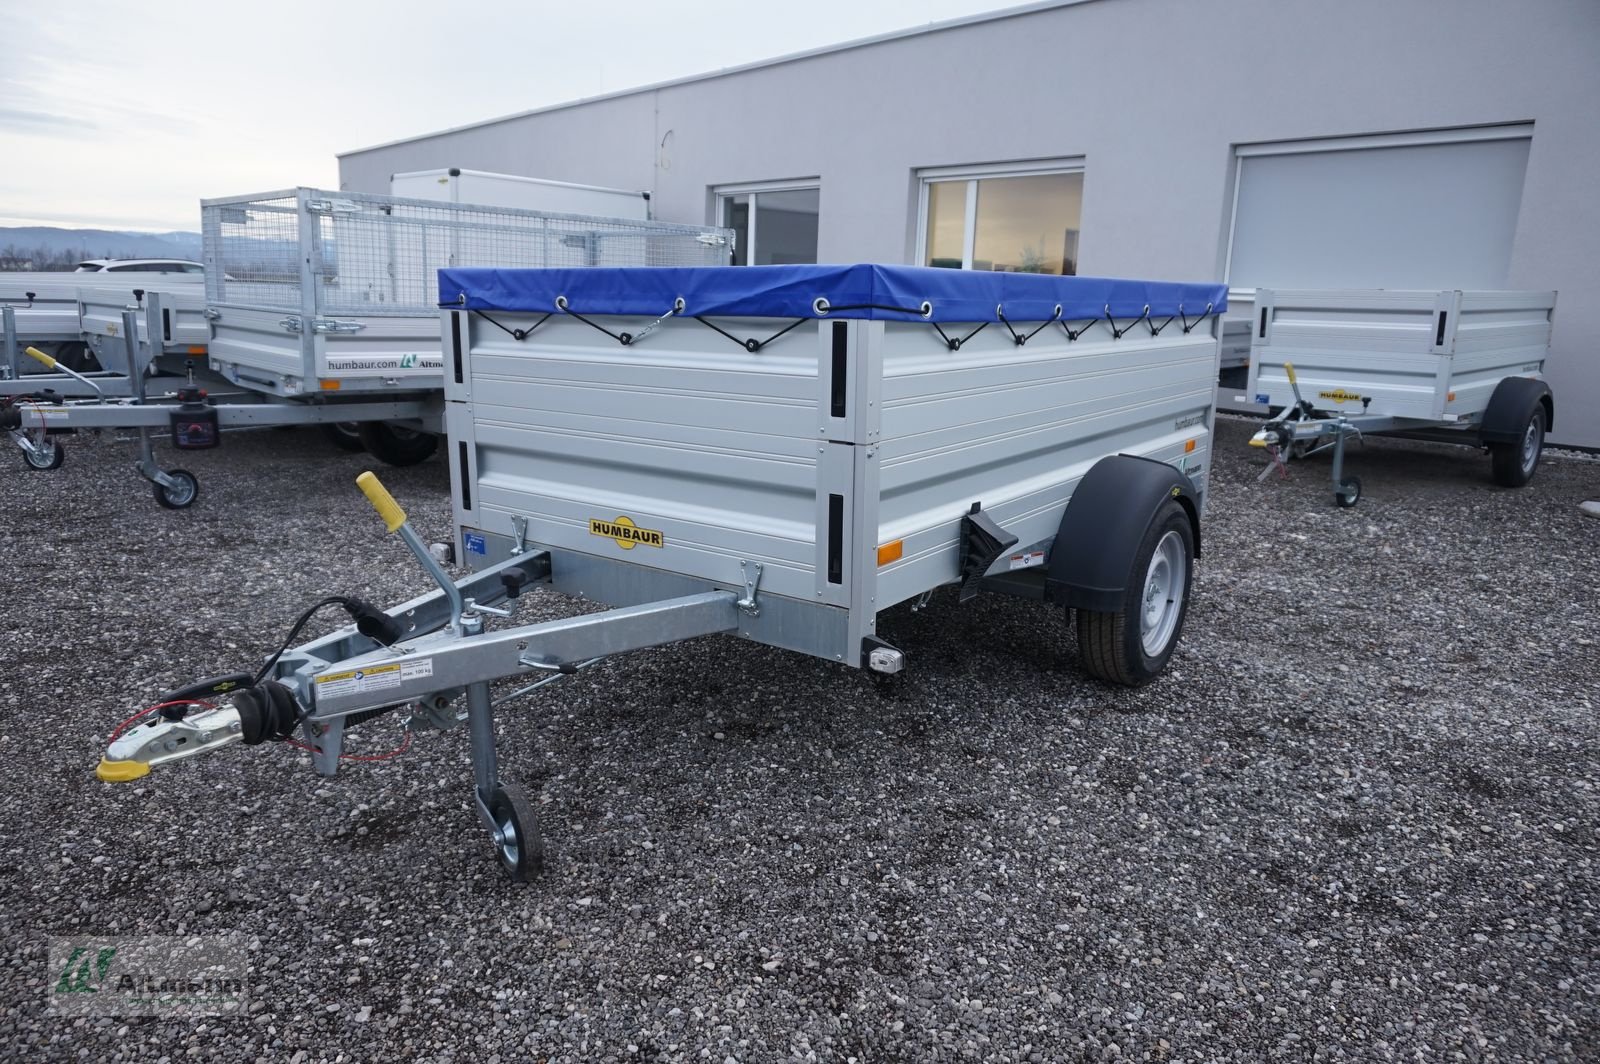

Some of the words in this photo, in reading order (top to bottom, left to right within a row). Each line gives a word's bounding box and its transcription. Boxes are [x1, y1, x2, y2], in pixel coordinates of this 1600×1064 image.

[328, 360, 397, 370] humbaur.com
[1320, 392, 1360, 400] HUMBAUR
[592, 521, 660, 545] HUMBAUR
